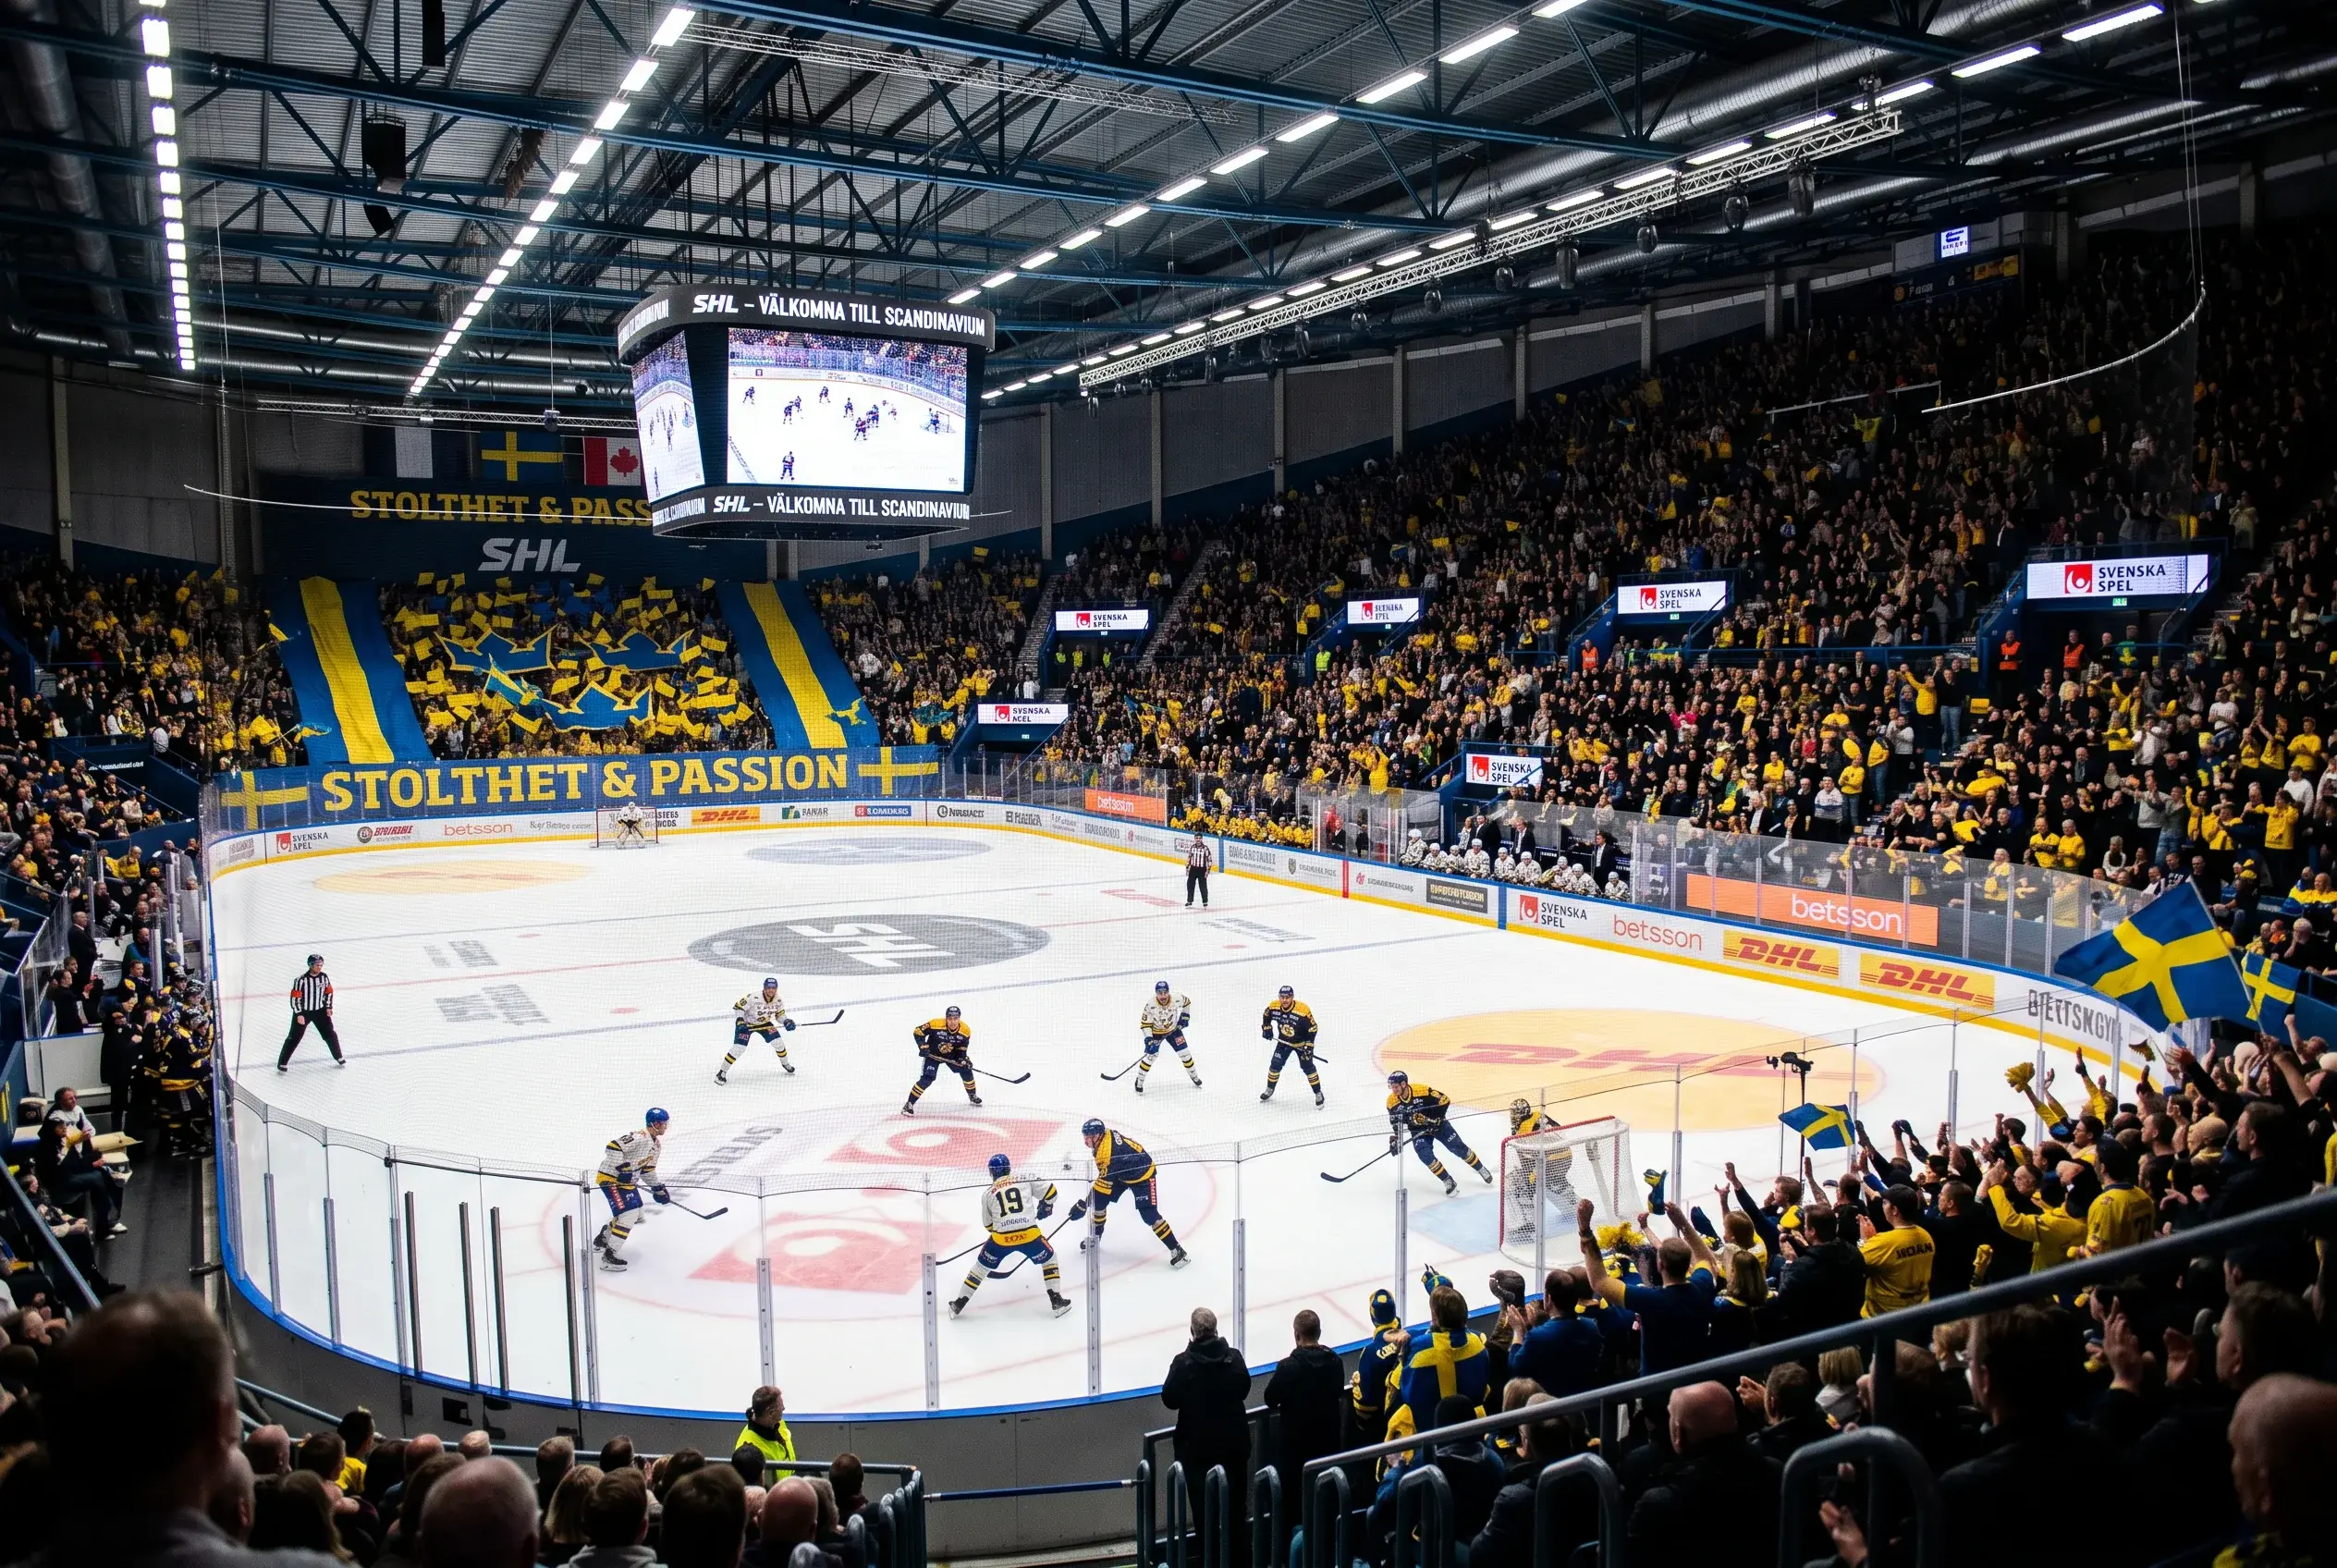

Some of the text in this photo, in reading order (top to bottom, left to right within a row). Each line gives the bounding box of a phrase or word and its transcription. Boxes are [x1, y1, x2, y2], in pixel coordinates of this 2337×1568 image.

[692, 294, 739, 313] SHL
[759, 293, 845, 321] VÄLKOMNA
[850, 302, 880, 324] TILL
[885, 306, 985, 337] SCANDINAVIUM
[350, 490, 529, 523] STOLTHET
[539, 496, 562, 524] &
[714, 496, 751, 513] SHL
[766, 493, 846, 515] VÄLKOMNA
[849, 498, 878, 516] TILL
[477, 537, 581, 572] SHL
[2098, 565, 2166, 579] SVENSKA
[1659, 588, 1702, 598] SVENSKA
[2098, 580, 2134, 592] SPEL
[1659, 599, 1682, 609] SPEL
[1491, 762, 1532, 774] SVENSKA
[1491, 773, 1512, 783] SPEL
[322, 753, 848, 812] STOLTHET & PASSION
[701, 809, 752, 823] DHL
[292, 832, 329, 842] SVENSKA
[444, 822, 513, 836] betsson
[1541, 901, 1587, 920] SVENSKA
[1792, 893, 1903, 935] betsson
[1541, 914, 1565, 929] SPEL
[1613, 914, 1703, 950] betsson
[1738, 937, 1822, 973] DHL
[1877, 962, 1976, 1001] DHL
[1446, 1042, 1812, 1078] DHL
[996, 1187, 1024, 1218] 19
